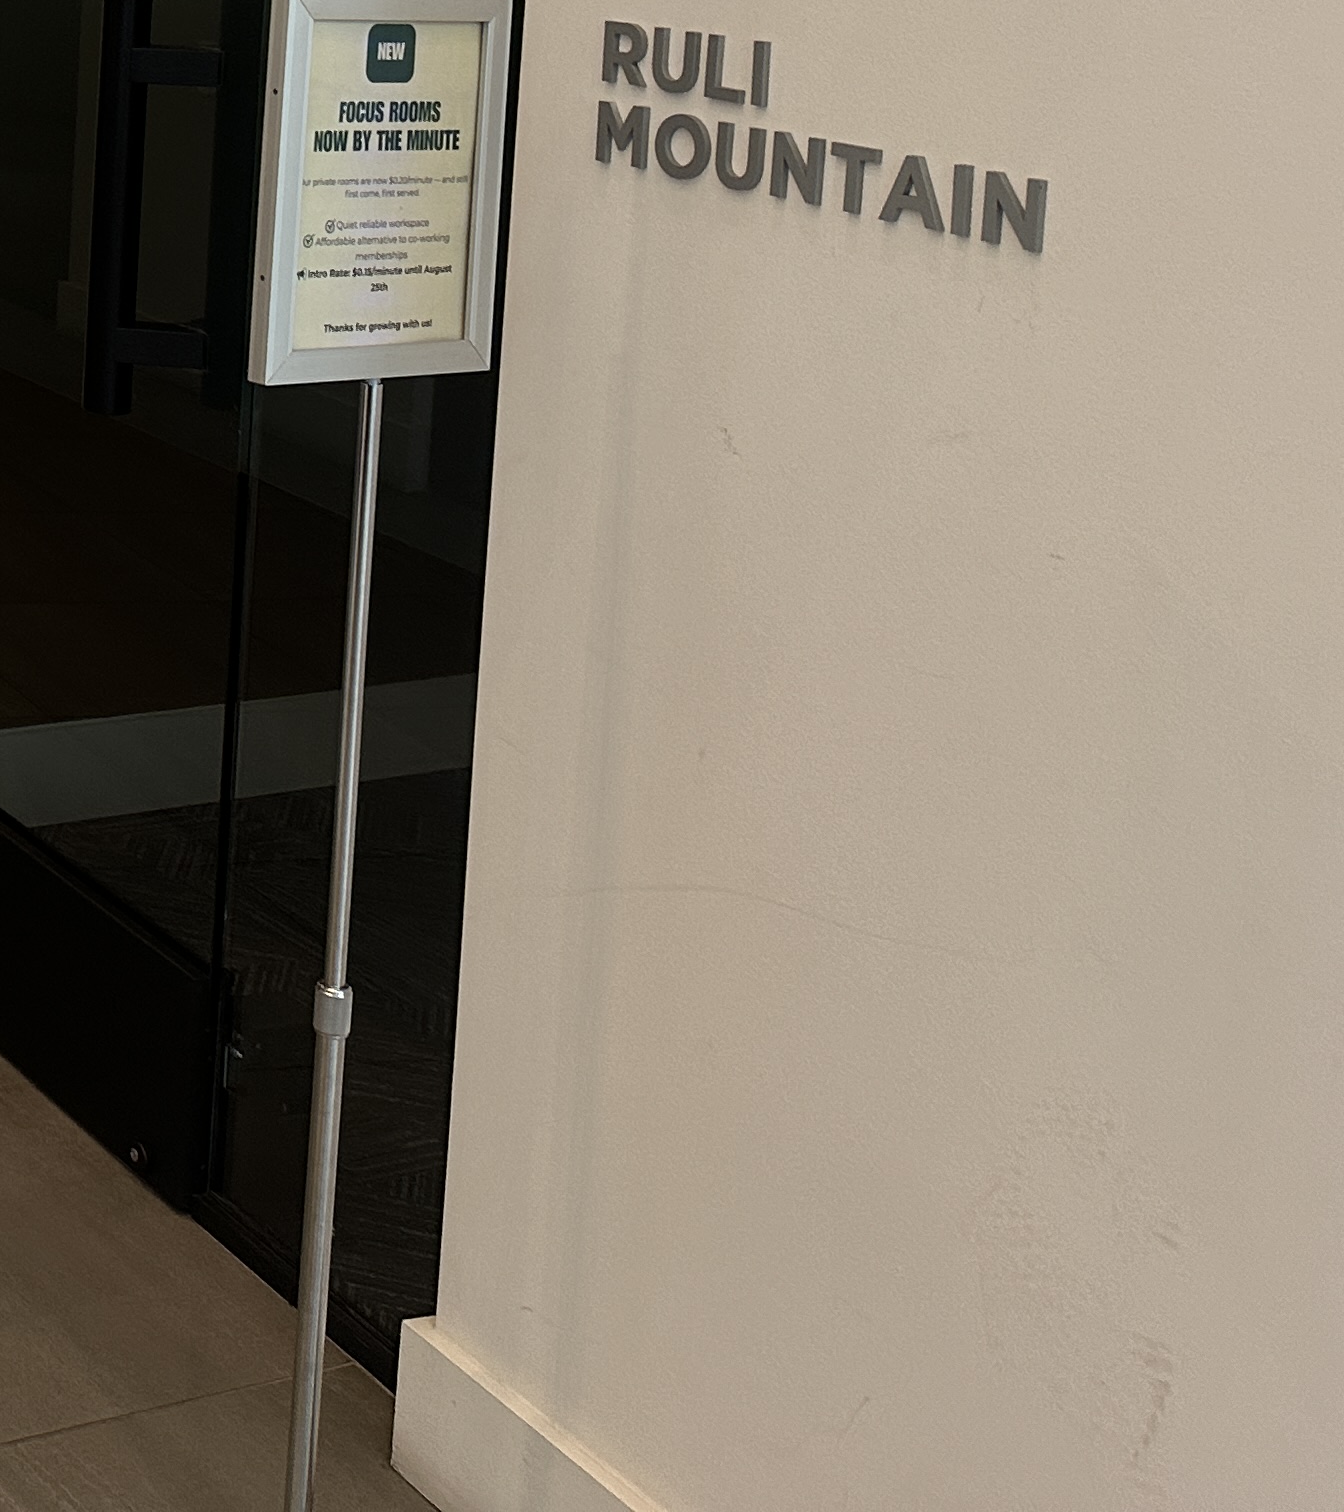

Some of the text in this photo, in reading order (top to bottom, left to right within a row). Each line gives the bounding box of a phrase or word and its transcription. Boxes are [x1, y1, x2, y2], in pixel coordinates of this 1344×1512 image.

[377, 41, 406, 61] NEW
[601, 20, 772, 109] RULI
[338, 101, 442, 123] FOCUS ROOMS
[313, 129, 460, 153] NOW BY THE MINUTE
[594, 99, 1049, 255] MOUNTAIN
[344, 189, 359, 198] first
[381, 188, 395, 198] first
[359, 218, 387, 229] reliable
[388, 218, 430, 229] workspace
[315, 233, 451, 246] Affordable alternative to co-working
[355, 250, 409, 262] memberships
[307, 269, 327, 279] Intro
[403, 264, 423, 275] until
[423, 264, 453, 276] August
[323, 323, 354, 334] Thanks
[355, 321, 367, 332] for
[368, 320, 401, 334] growing
[401, 319, 420, 329] with
